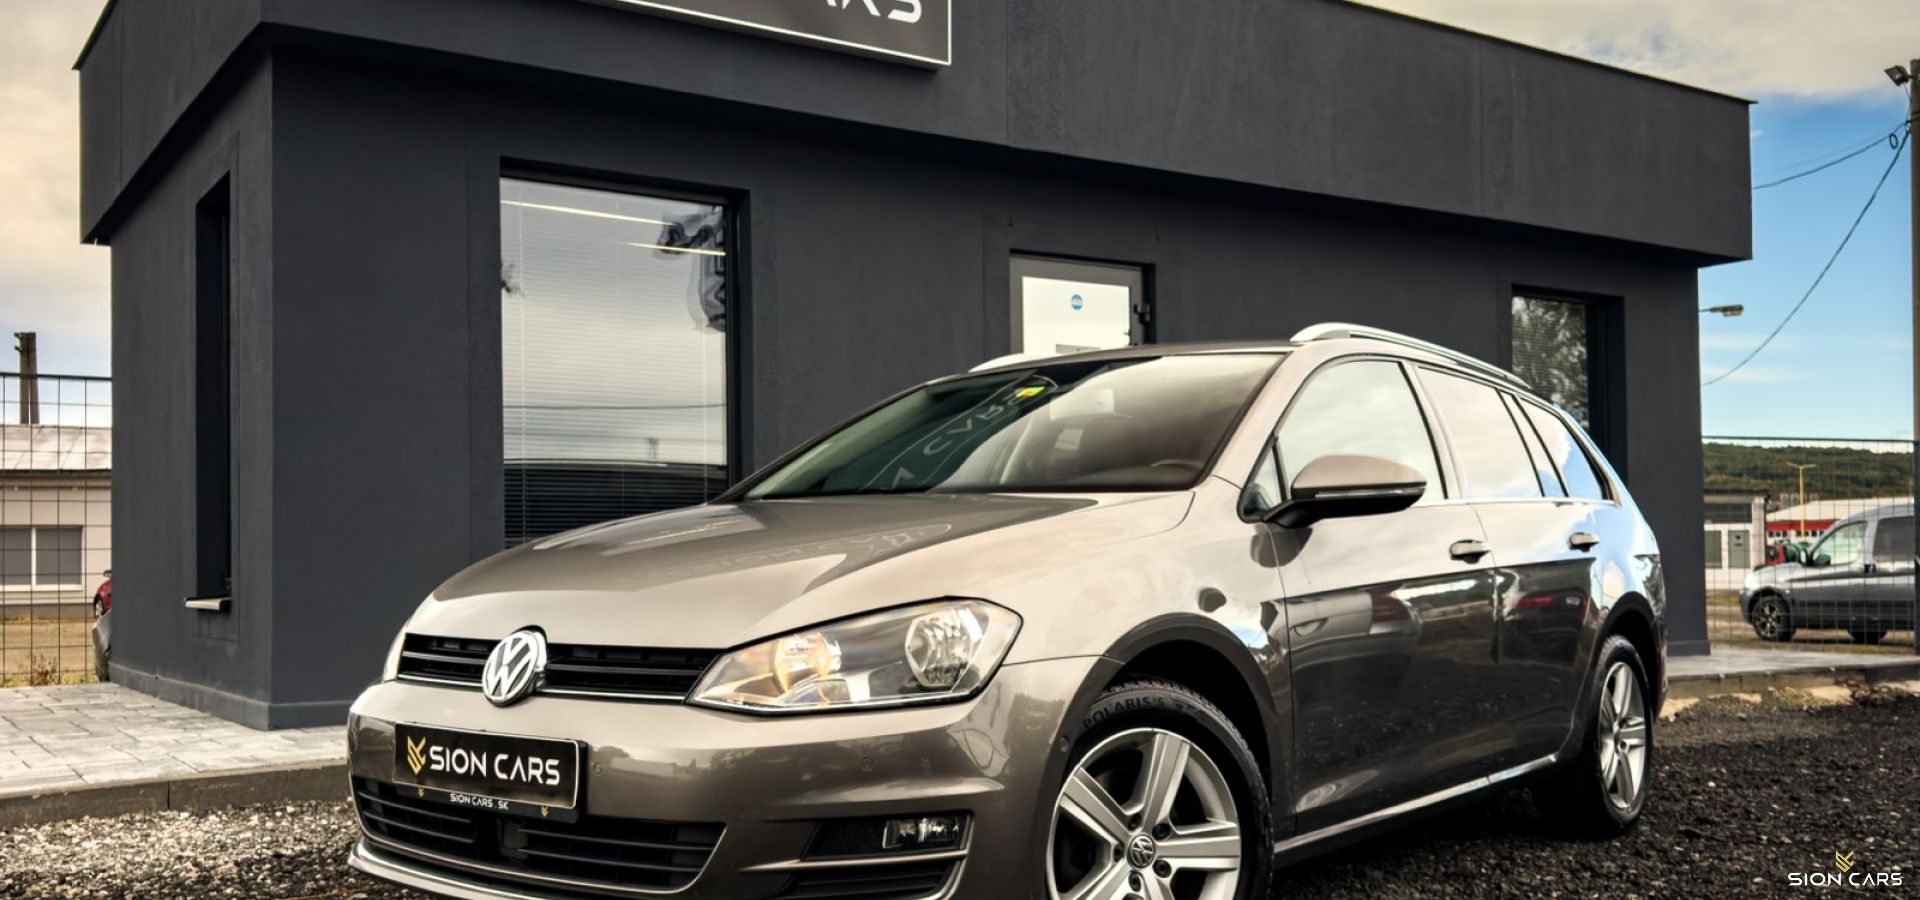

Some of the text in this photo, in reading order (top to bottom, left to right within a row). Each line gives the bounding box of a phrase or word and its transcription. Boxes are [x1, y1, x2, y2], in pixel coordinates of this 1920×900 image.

[482, 630, 539, 701] VW
[1083, 696, 1152, 729] POLARIS
[429, 745, 560, 785] SION CARS
[450, 793, 470, 804] SION
